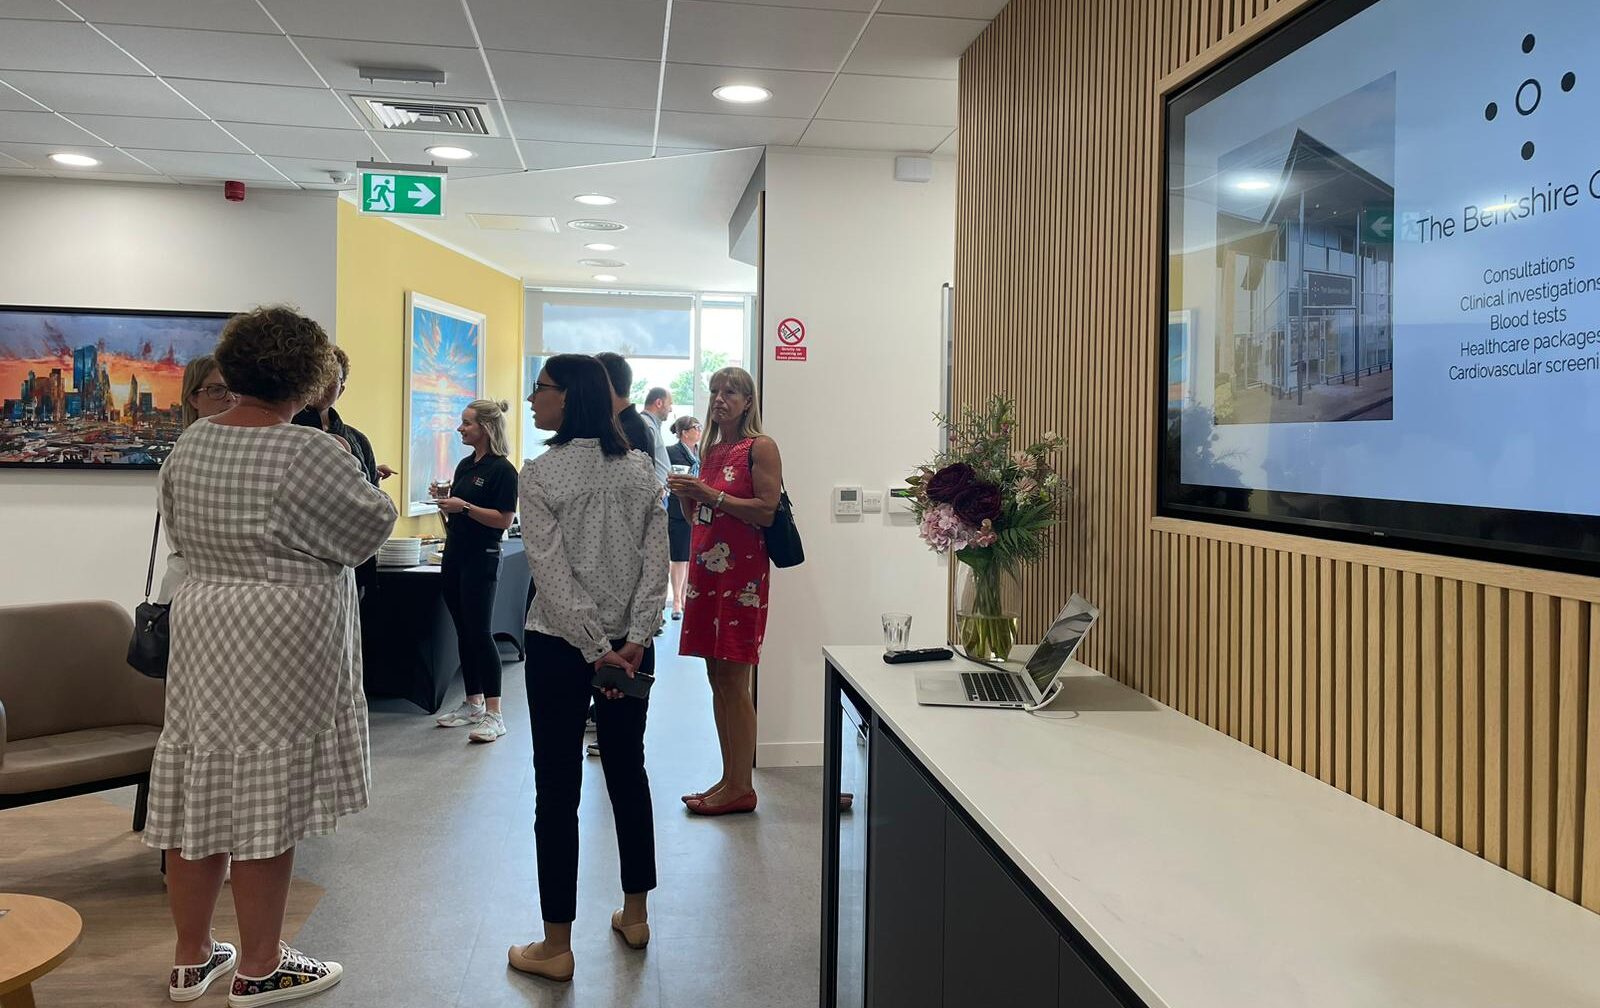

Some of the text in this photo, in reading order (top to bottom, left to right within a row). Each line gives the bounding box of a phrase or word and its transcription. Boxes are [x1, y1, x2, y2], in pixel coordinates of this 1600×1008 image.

[1416, 215, 1455, 243] The
[1463, 182, 1579, 233] Berkshire
[1483, 255, 1576, 285] Consultations
[1460, 276, 1600, 312] Clinical investigations
[1490, 306, 1567, 331] Blood tests
[1460, 328, 1600, 357] Healthcare packages
[1449, 351, 1600, 381] Cardiovascular screeni
